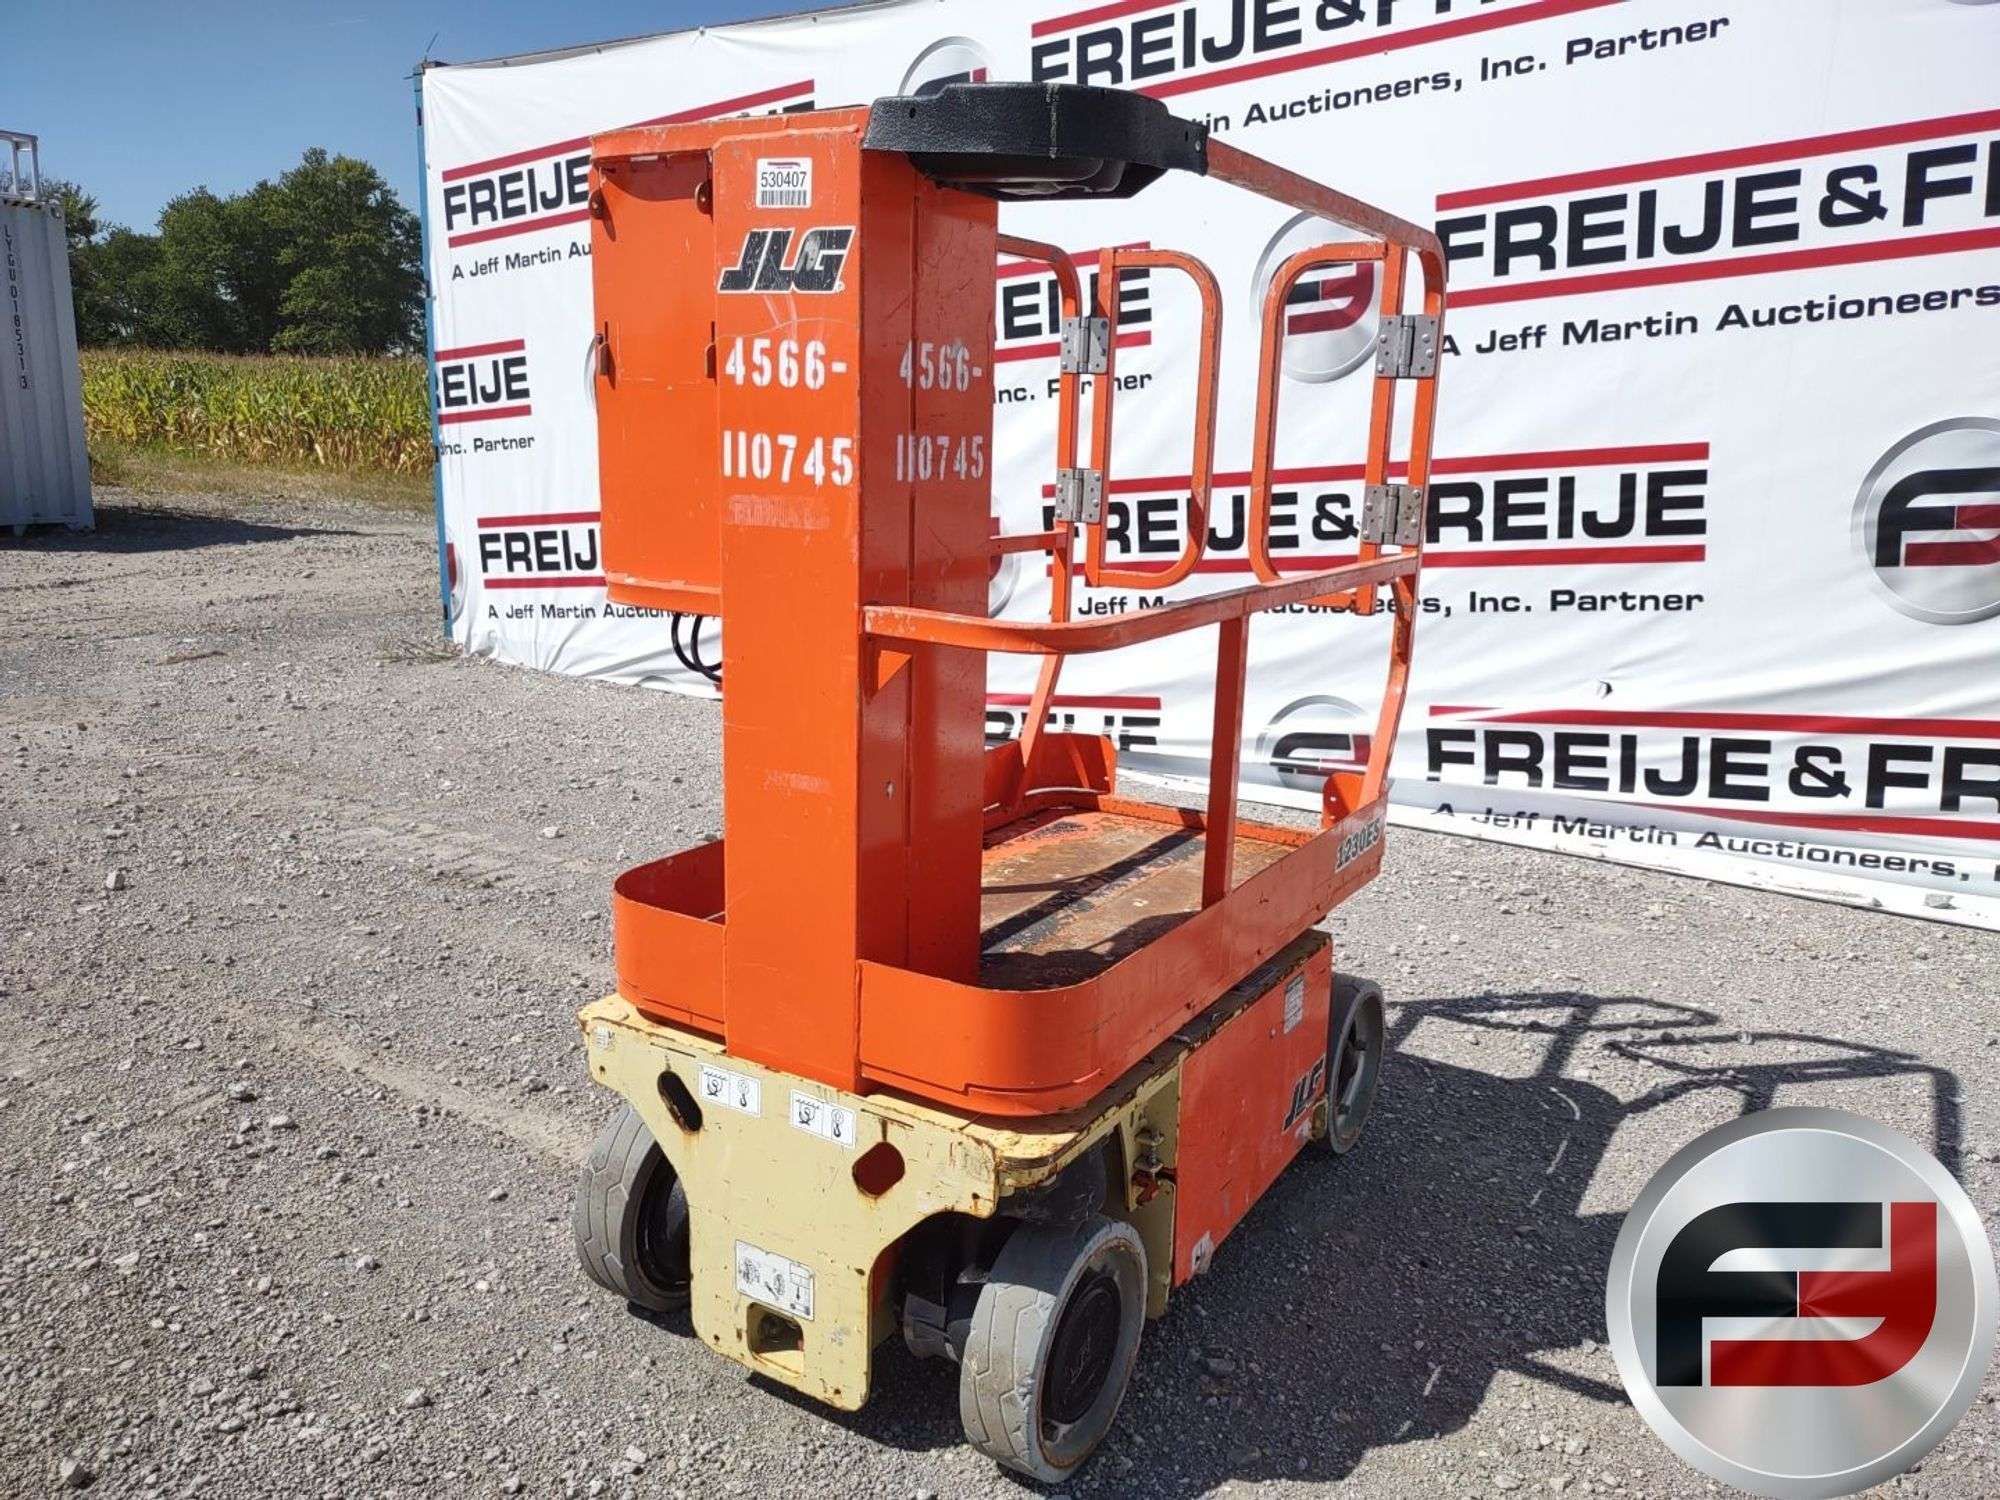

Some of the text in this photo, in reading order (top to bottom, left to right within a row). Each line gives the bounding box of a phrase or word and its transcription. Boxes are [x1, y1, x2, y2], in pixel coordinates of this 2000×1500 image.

[1032, 0, 1302, 85] FREIJE
[1243, 71, 1462, 127] Auctioneers,
[1480, 55, 1546, 81] Inc.
[1565, 17, 1730, 65] Partner
[443, 154, 591, 231] FREIJE
[761, 171, 807, 188] 530407
[1434, 168, 1802, 283] FREIJE
[1818, 164, 1888, 228] &
[452, 264, 464, 281] A
[469, 256, 500, 277] Jeff
[505, 246, 562, 270] Martin
[718, 226, 856, 294] JLG
[1475, 324, 1547, 354] Jeff
[1562, 311, 1698, 346] Martin
[725, 337, 848, 390] 4566-
[899, 339, 982, 391] 4566-
[473, 436, 535, 454] Partner
[723, 430, 853, 486] 110745
[1312, 493, 1359, 541] &
[479, 528, 597, 573] FREIJ
[488, 605, 498, 618] A
[506, 604, 534, 619] Jeff
[541, 604, 596, 619] Martin
[1078, 596, 1127, 615] Jeff
[1469, 591, 1532, 612] Inc.
[1550, 589, 1704, 611] Partner
[1427, 728, 1772, 802] FREIJE
[1789, 745, 1852, 798] &
[1552, 814, 1677, 845] Martin
[1694, 831, 1970, 881] Auctioneers,
